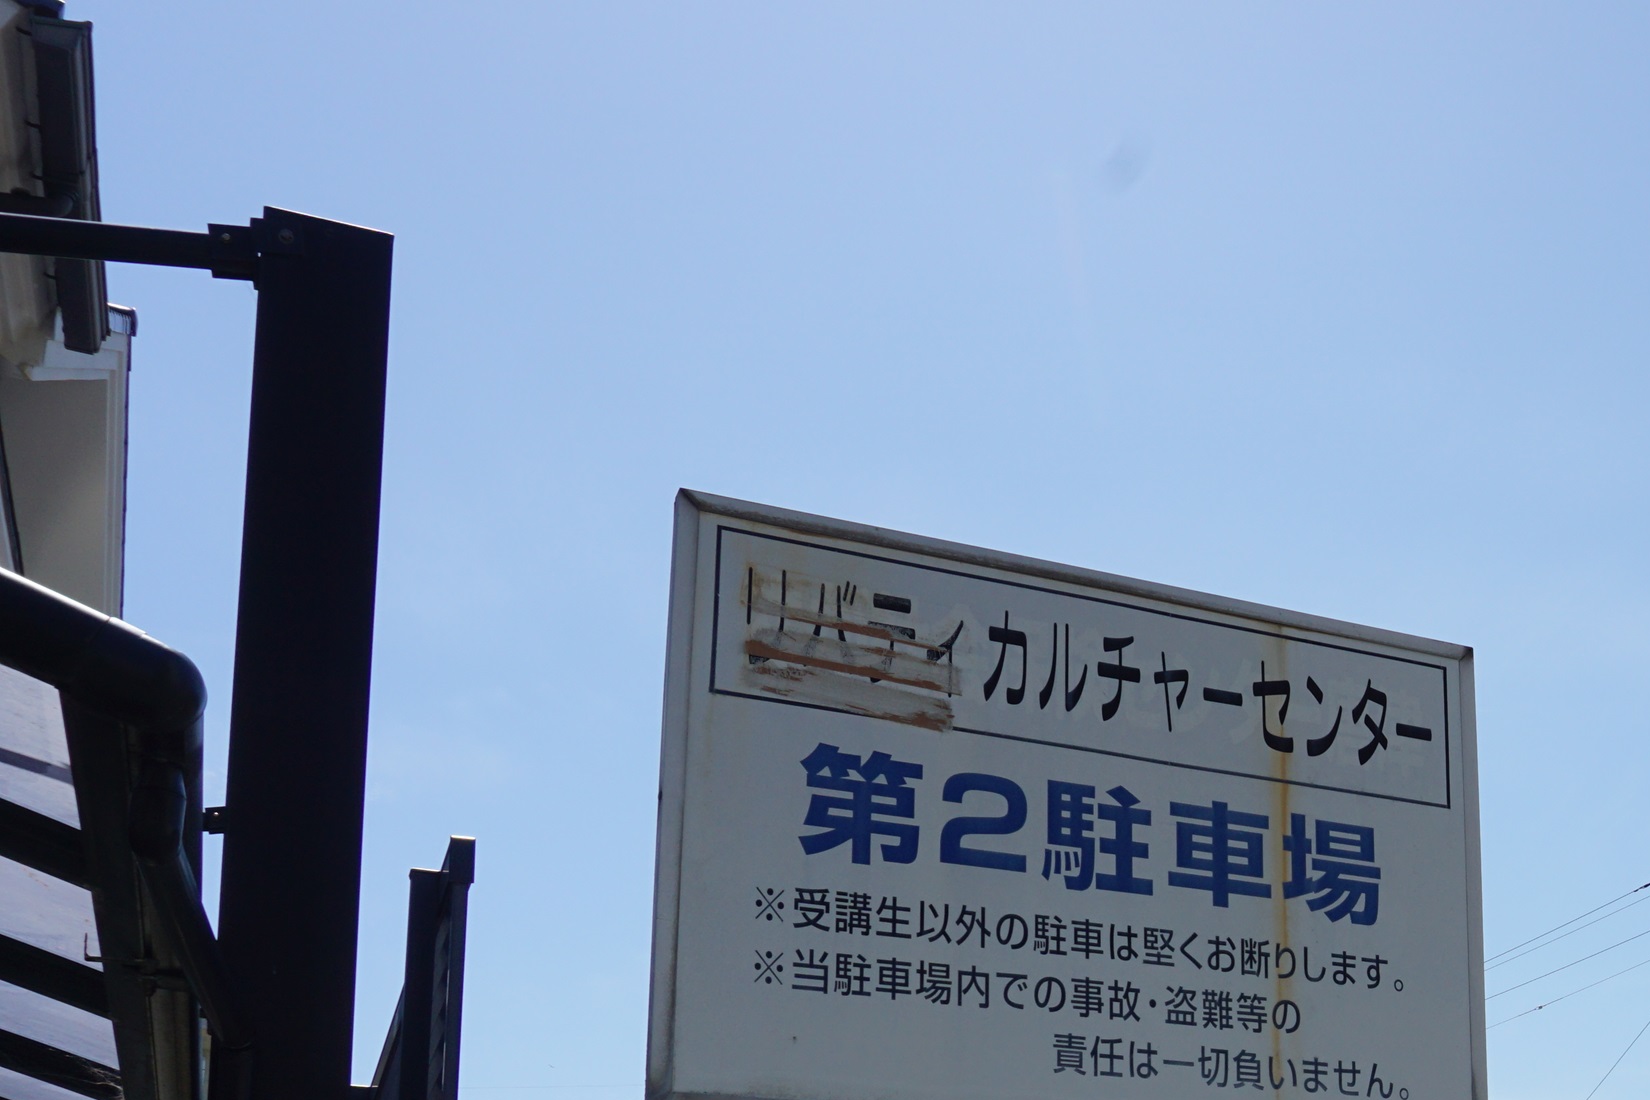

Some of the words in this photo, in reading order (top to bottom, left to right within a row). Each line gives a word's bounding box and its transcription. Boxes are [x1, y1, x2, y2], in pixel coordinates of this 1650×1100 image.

[797, 742, 1382, 926] 第2駐車場
[1052, 1032, 1410, 1100] 責任は一切負いません。
